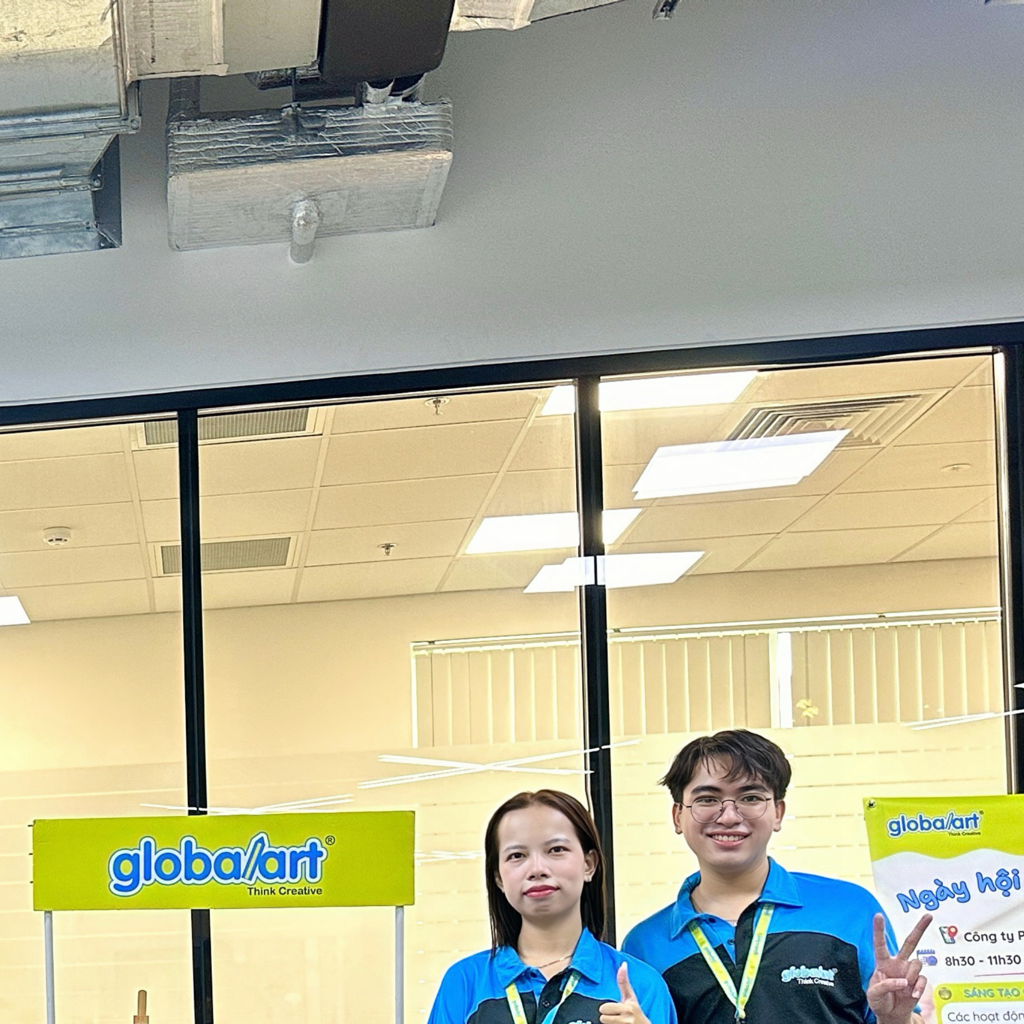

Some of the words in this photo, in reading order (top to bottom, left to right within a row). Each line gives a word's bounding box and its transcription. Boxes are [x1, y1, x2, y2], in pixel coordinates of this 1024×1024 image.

[247, 887, 276, 896] Think
[279, 886, 323, 896] Creative
[896, 878, 971, 913] Ngày
[975, 868, 1021, 897] hội
[964, 931, 997, 943] Công
[1000, 931, 1014, 943] ty
[945, 956, 975, 966] 8h30
[987, 955, 1022, 965] 11h30
[963, 986, 994, 998] SÁNG
[997, 988, 1020, 999] TẠO
[947, 1011, 970, 1022] Các
[973, 1011, 1000, 1023] hoạt
